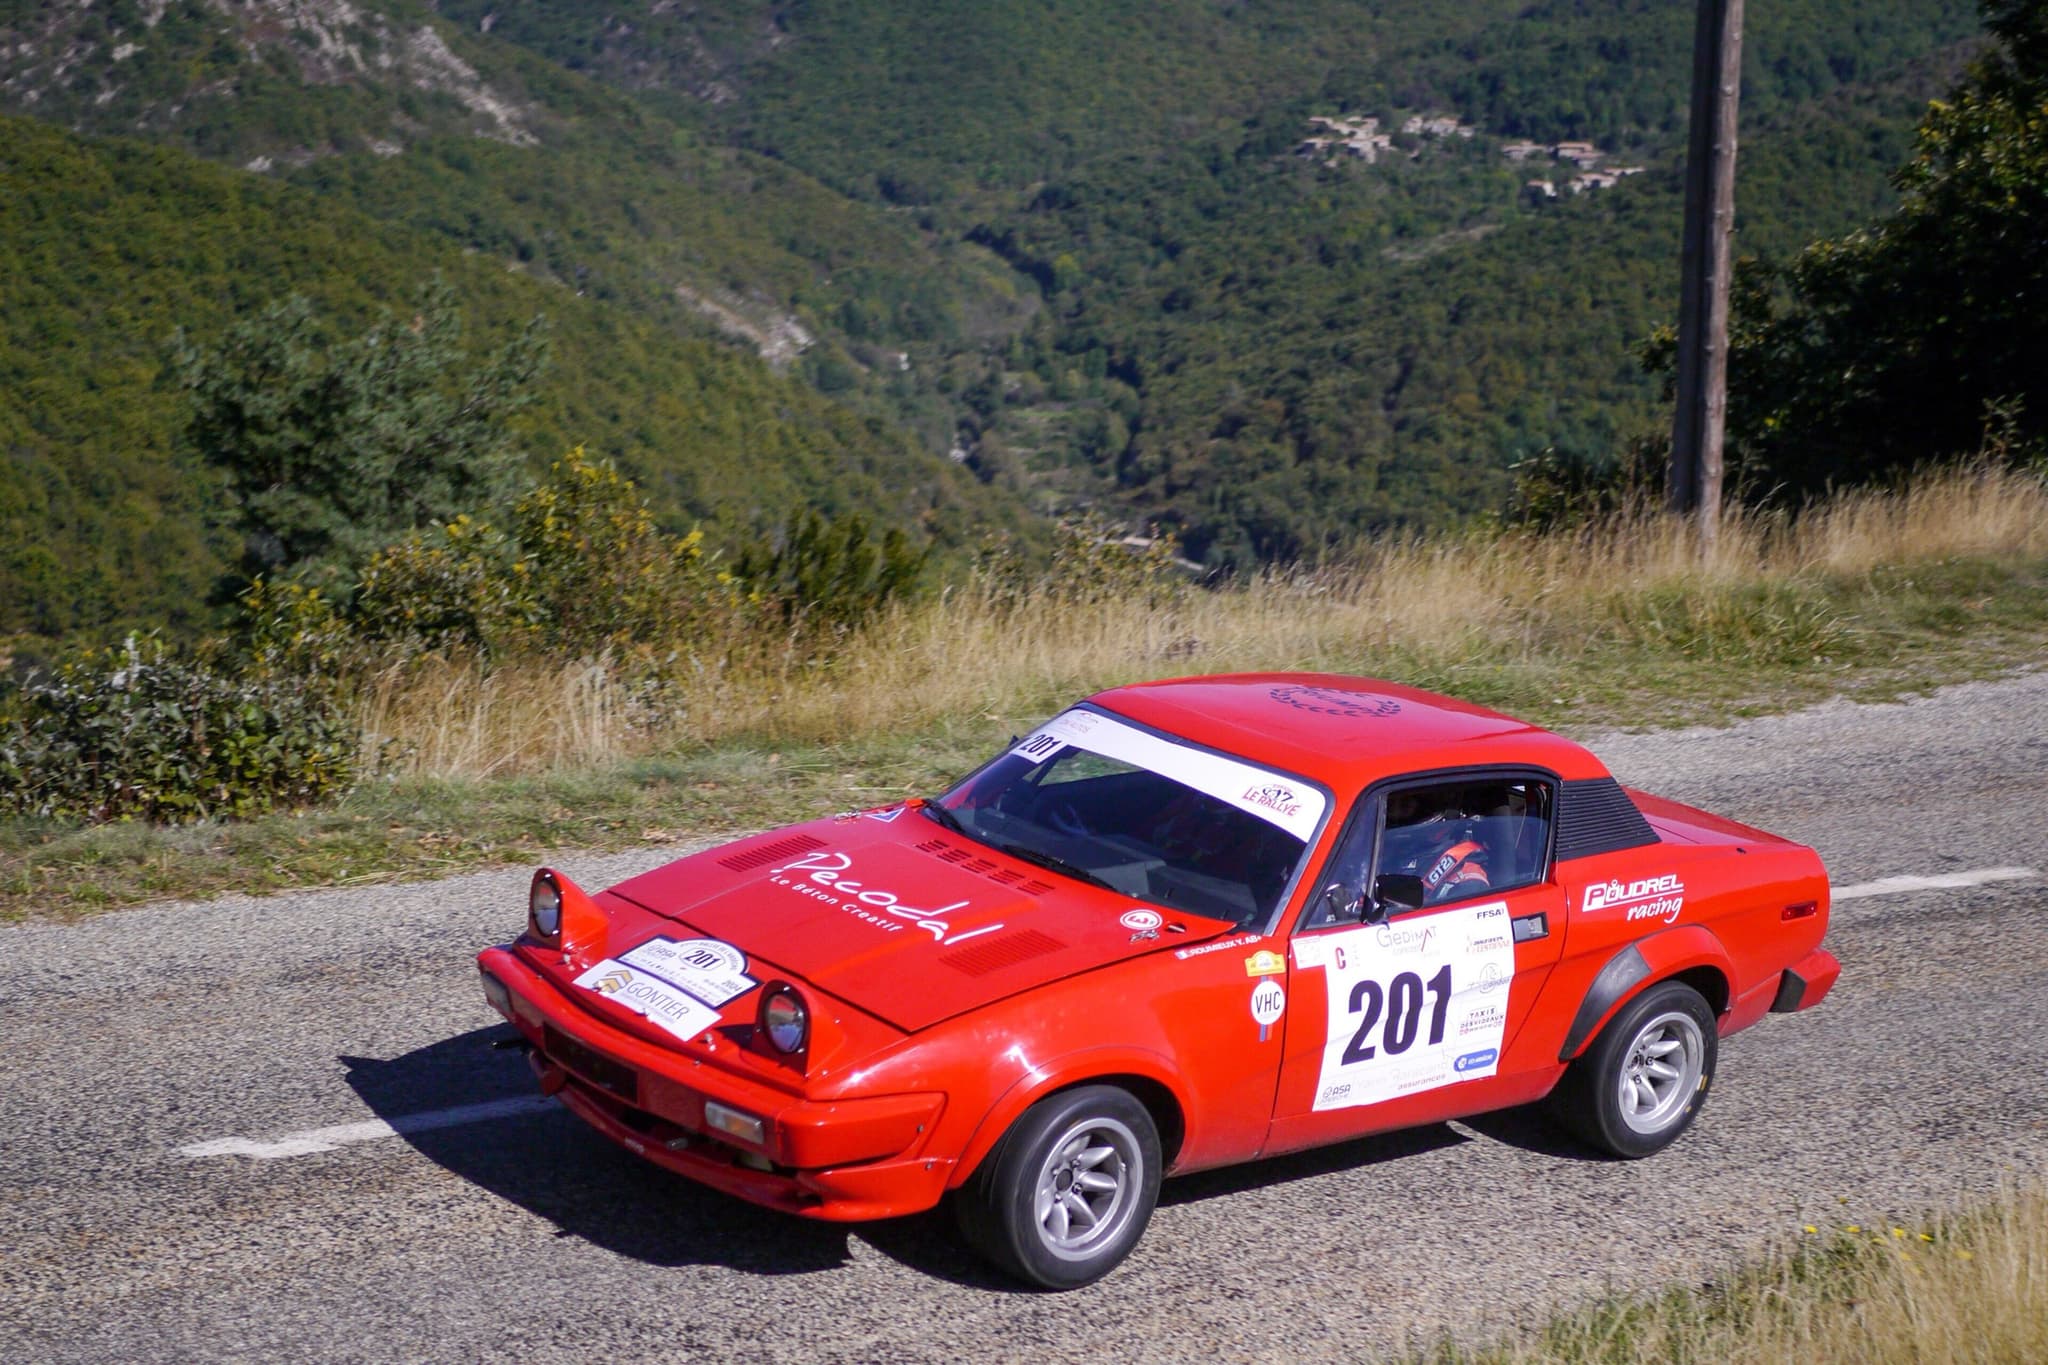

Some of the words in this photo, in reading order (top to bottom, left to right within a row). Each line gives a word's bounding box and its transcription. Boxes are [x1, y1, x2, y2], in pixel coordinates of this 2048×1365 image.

[1019, 734, 1062, 756] 201
[1242, 786, 1260, 801] LE
[1257, 795, 1302, 816] RALLYE
[769, 875, 791, 886] Le
[792, 883, 838, 905] Béton
[1477, 909, 1502, 920] FFSA
[1627, 897, 1683, 923] racing
[684, 949, 721, 969] 201
[627, 982, 690, 1020] GONTIER
[1255, 991, 1281, 1014] VHC
[1340, 964, 1453, 1066] 201
[1470, 1008, 1495, 1019] TAXIS
[1332, 1084, 1351, 1096] ASA
